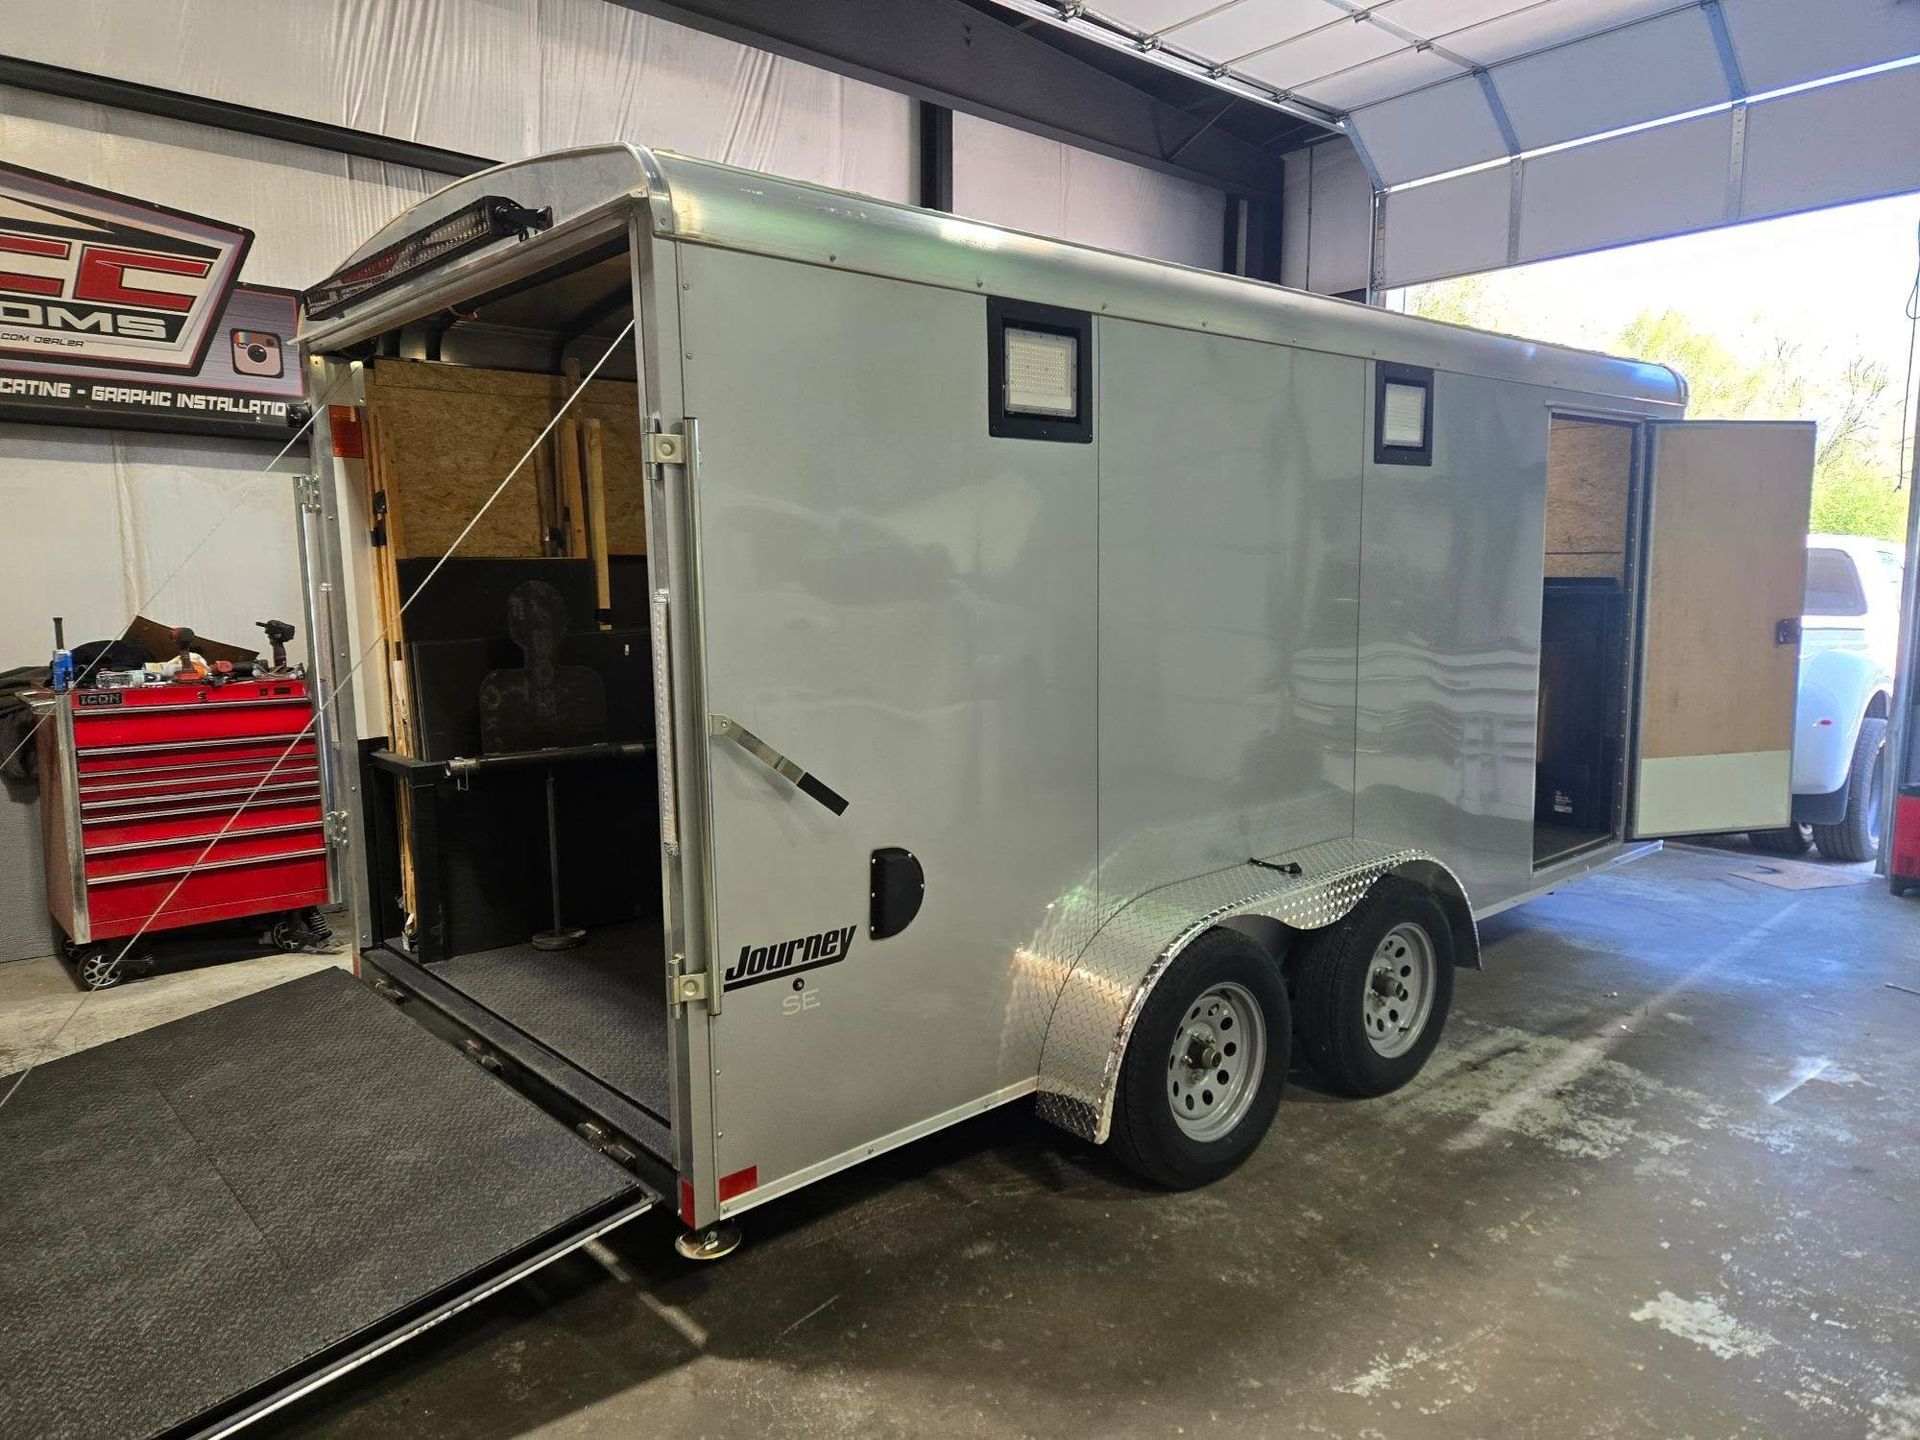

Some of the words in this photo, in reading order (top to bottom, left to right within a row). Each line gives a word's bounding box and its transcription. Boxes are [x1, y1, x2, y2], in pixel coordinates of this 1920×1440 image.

[91, 385, 172, 407] GRAPHIC
[80, 694, 120, 705] ICON
[724, 924, 857, 989] Journey
[782, 988, 820, 1016] SE
